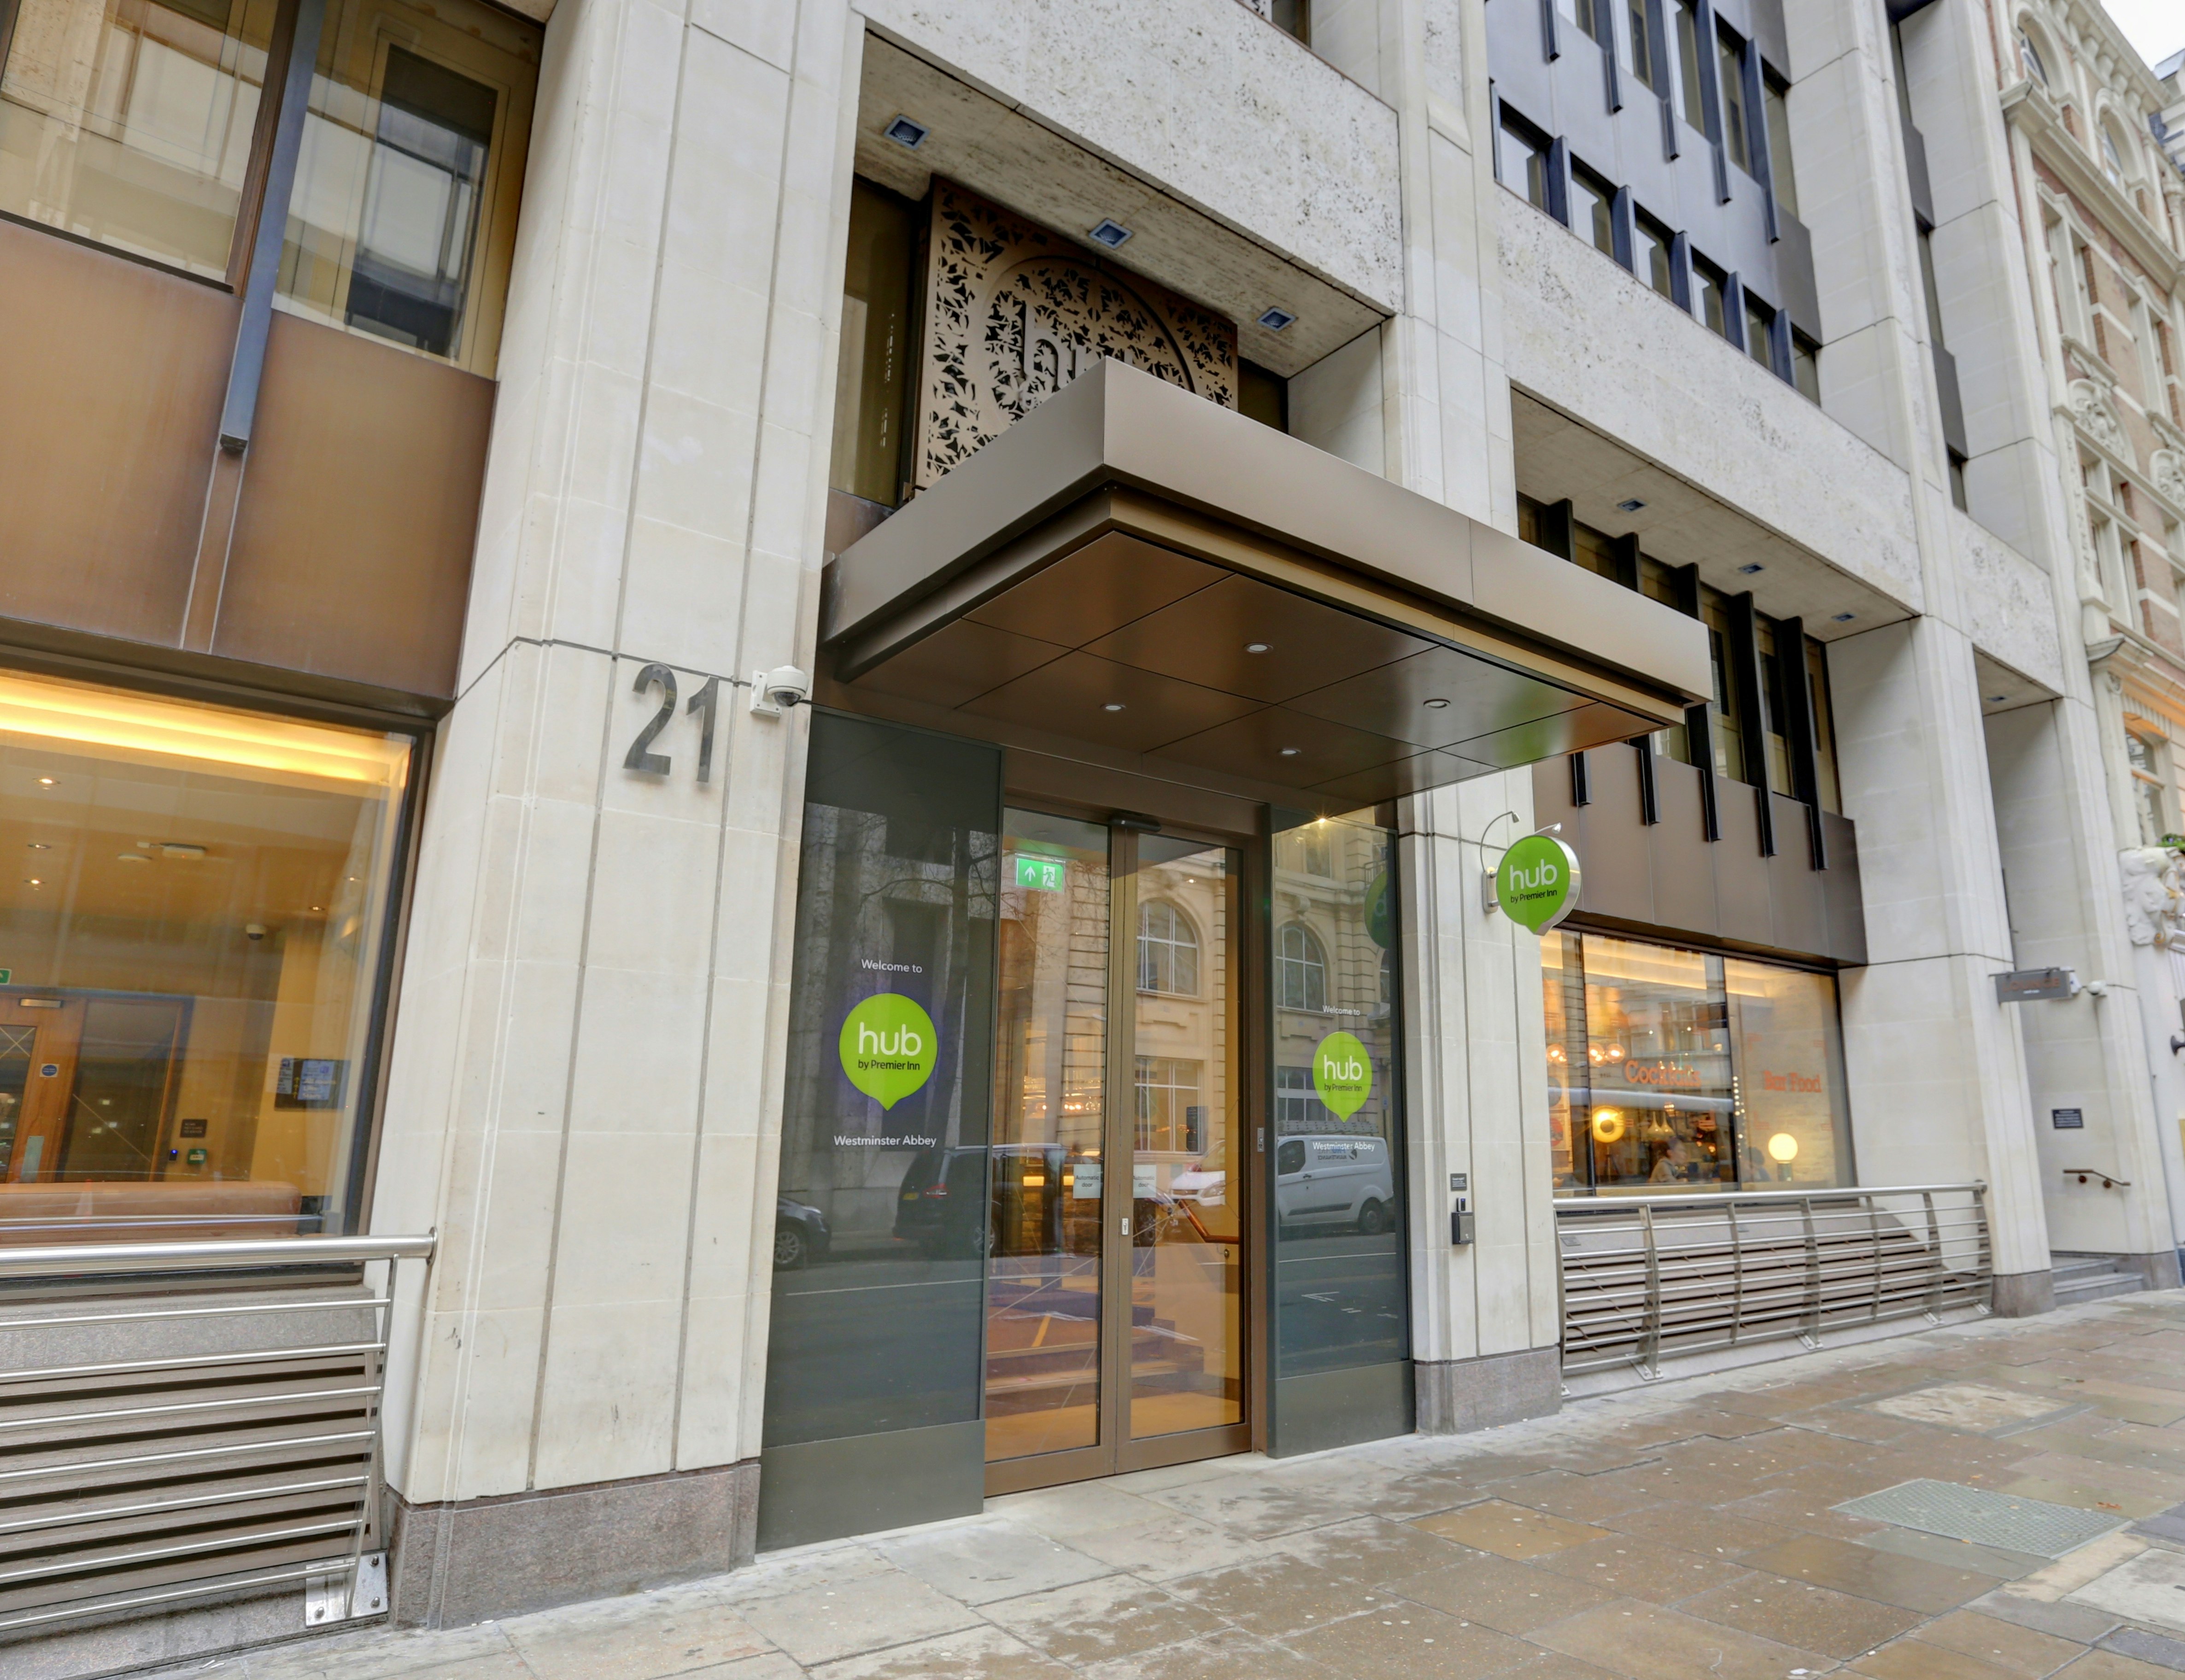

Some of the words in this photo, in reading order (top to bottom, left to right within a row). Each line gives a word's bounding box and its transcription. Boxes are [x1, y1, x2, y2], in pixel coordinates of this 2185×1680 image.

[623, 662, 719, 783] 21
[1510, 859, 1558, 891] hub
[1511, 895, 1519, 904] by
[1520, 891, 1545, 901] Premier
[861, 959, 910, 972] Welcome
[912, 963, 922, 973] to
[1323, 1005, 1353, 1015] Welcome
[859, 1021, 921, 1056] hub
[858, 1060, 870, 1071] by
[871, 1060, 905, 1070] Premier
[907, 1061, 920, 1071] Inn
[1324, 1054, 1362, 1081] hub
[1324, 1083, 1331, 1092] by
[1332, 1083, 1353, 1092] Premier
[1763, 1070, 1787, 1091] Bar
[1789, 1072, 1822, 1093] Food
[833, 1135, 900, 1146] Westminster
[902, 1135, 937, 1148] Abbey
[1312, 1142, 1353, 1150] Westminster
[1354, 1142, 1375, 1152] Abbey
